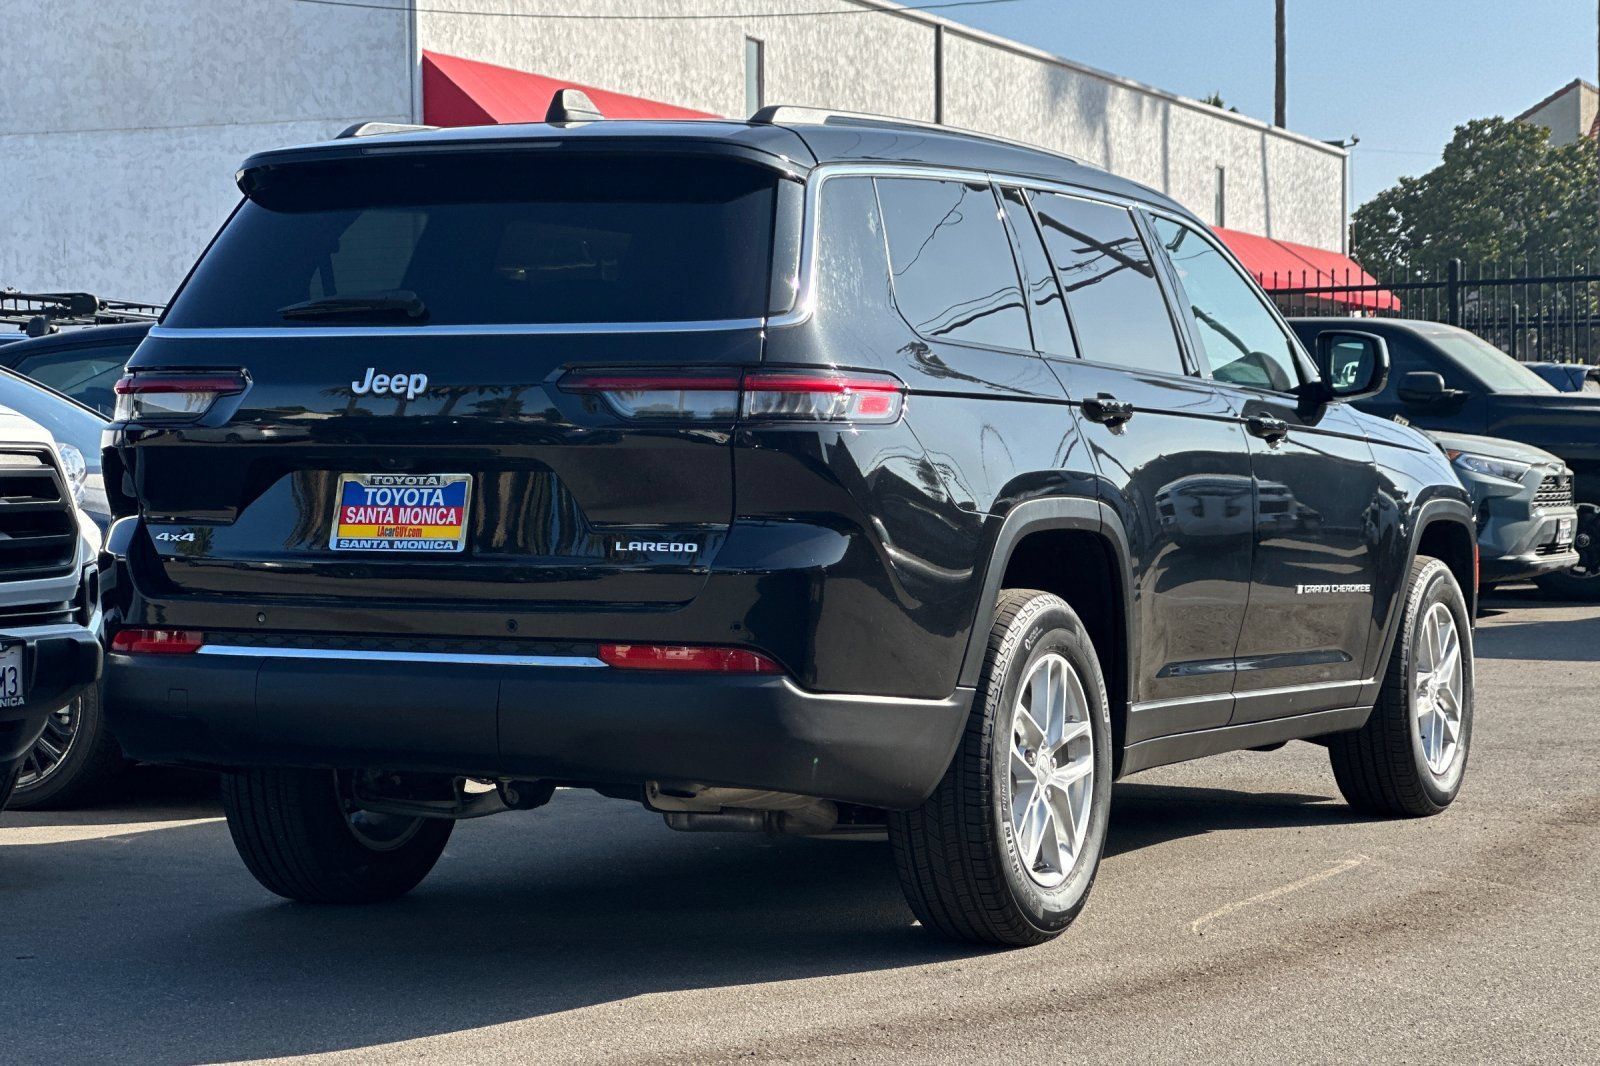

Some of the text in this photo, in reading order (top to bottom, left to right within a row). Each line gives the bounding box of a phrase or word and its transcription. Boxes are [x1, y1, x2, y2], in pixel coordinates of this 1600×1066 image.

[352, 367, 428, 399] Jeep
[372, 476, 438, 485] TOYOTA
[364, 488, 445, 506] TOYOTA
[345, 507, 457, 525] SANTA MONICA
[155, 532, 196, 542] 4x4
[377, 526, 423, 538] LAcarGUY.com
[339, 539, 454, 550] SANTA MONICA
[615, 541, 698, 552] LAREDO
[1304, 584, 1371, 594] GRAND CHEROKEE
